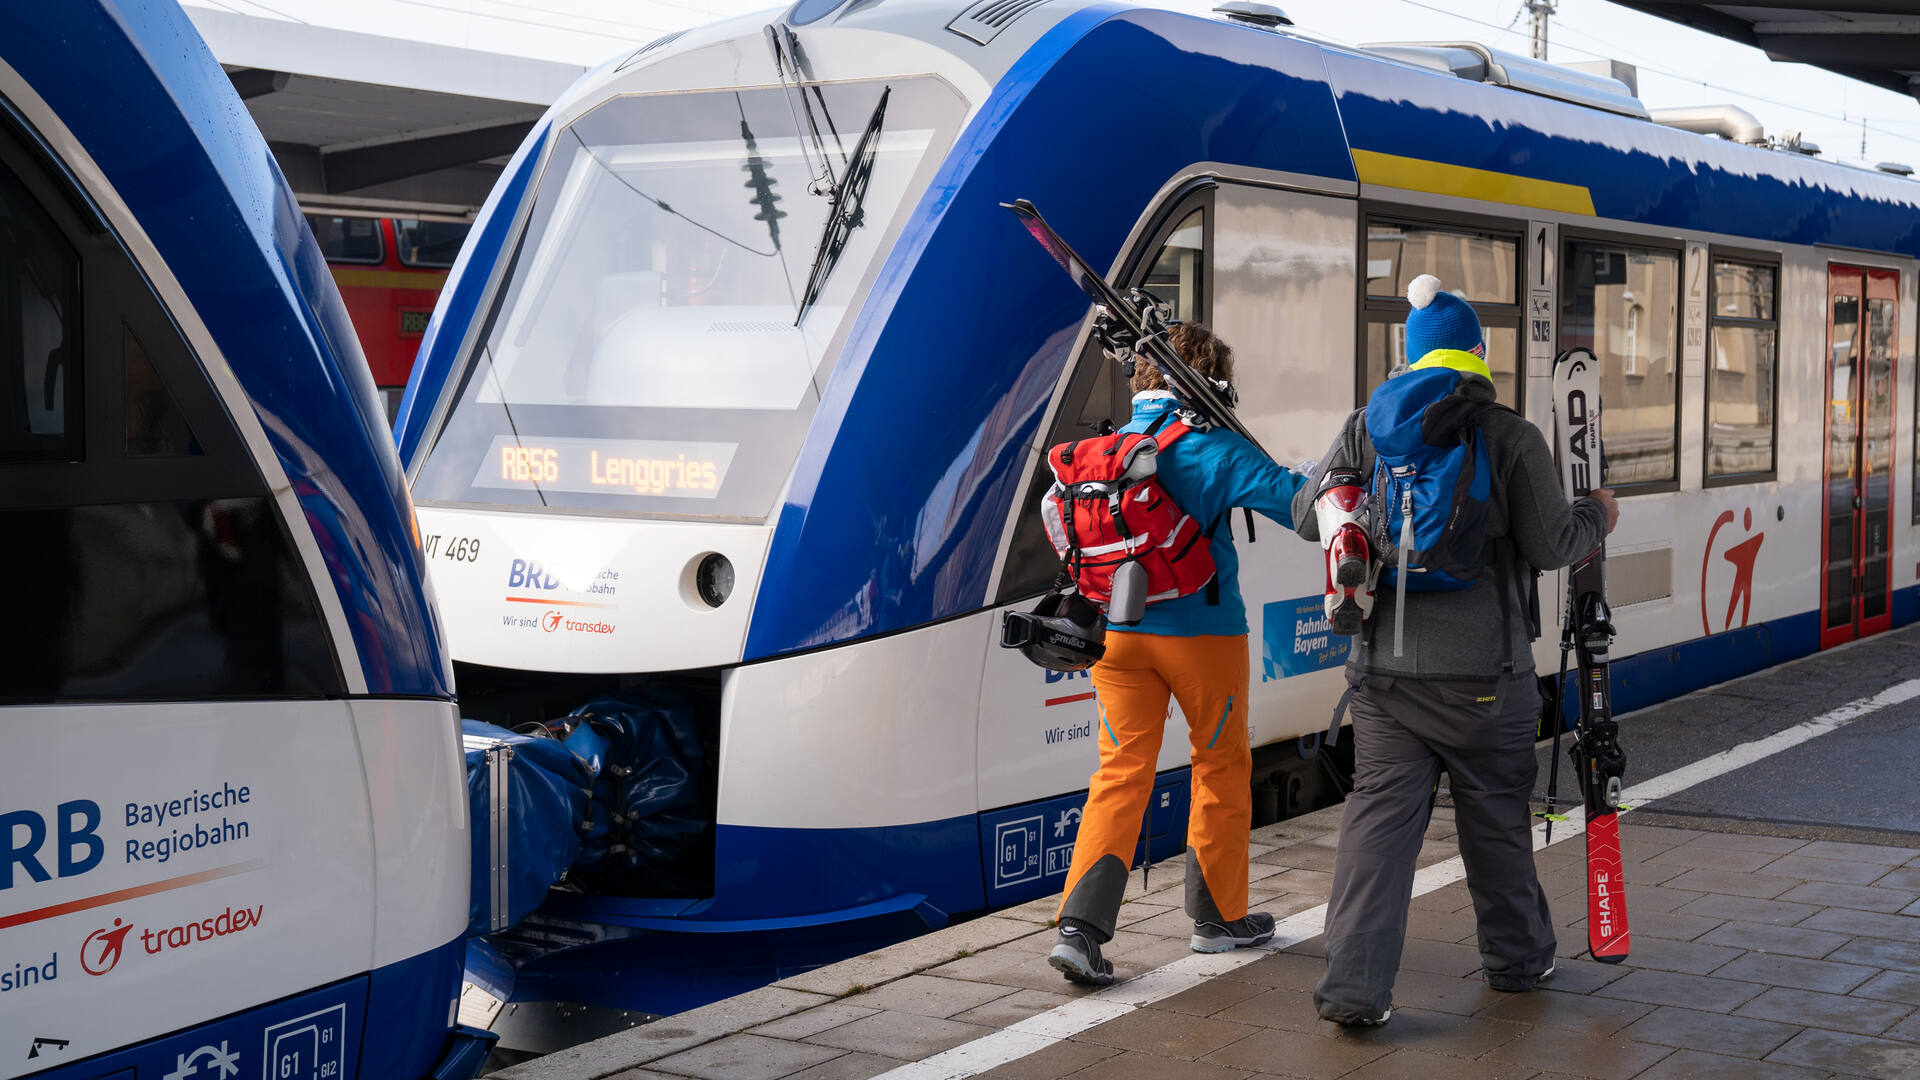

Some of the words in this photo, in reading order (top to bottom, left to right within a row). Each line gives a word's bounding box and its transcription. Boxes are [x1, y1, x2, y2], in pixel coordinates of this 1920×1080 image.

[1537, 227, 1546, 286] 1
[1567, 389, 1591, 499] EAD
[502, 446, 558, 482] RB56
[591, 449, 717, 493] Lenggries
[425, 534, 441, 559] VT
[445, 536, 480, 563] 469
[503, 615, 518, 626] Wir
[520, 616, 538, 628] sind
[565, 618, 616, 635] transdev
[1294, 636, 1328, 656] Bayern
[1045, 726, 1065, 745] Wir
[1068, 719, 1090, 741] sind
[125, 782, 251, 827] Bayerische
[125, 817, 250, 863] Regiobahn
[1005, 844, 1017, 862] G1
[1049, 852, 1057, 871] R
[1597, 872, 1612, 938] SHAPE
[0, 952, 58, 992] sind
[140, 904, 264, 955] transdev
[322, 1027, 334, 1044] G1
[281, 1051, 299, 1079] G1
